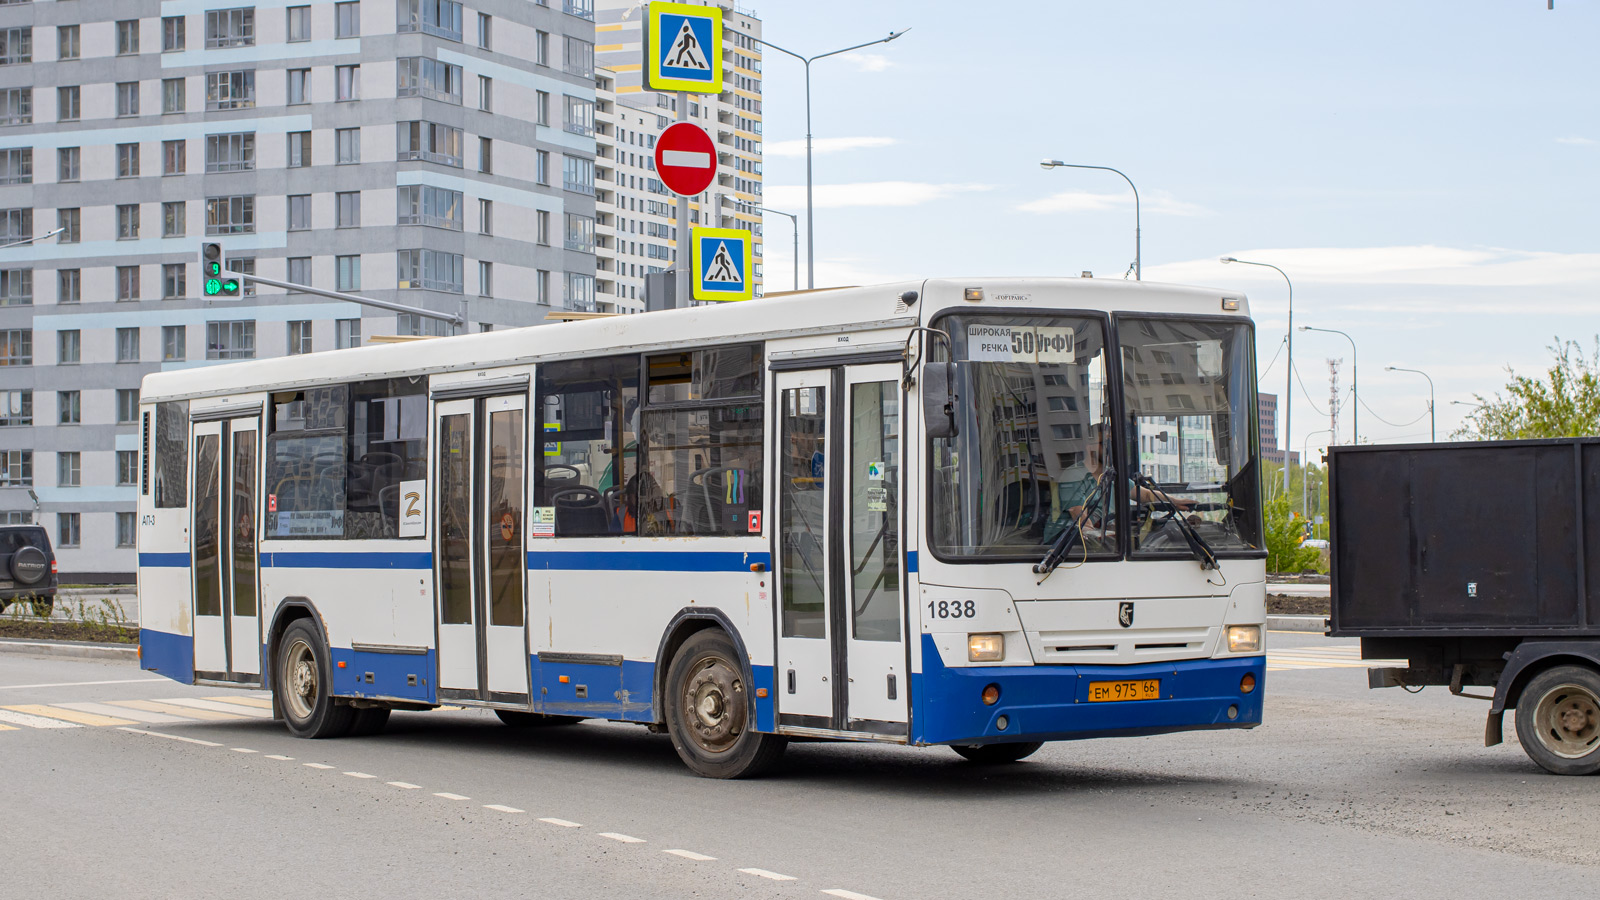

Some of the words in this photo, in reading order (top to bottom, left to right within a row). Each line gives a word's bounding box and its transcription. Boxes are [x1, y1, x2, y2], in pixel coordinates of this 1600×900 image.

[212, 263, 219, 275] 9
[969, 327, 1011, 337] ШИРОКАЯ
[981, 343, 1009, 352] РЕЧКА
[1011, 331, 1034, 354] 50
[1036, 334, 1074, 353] УрФУ
[142, 515, 155, 525] АП-3
[927, 600, 976, 618] 1838
[1114, 683, 1137, 698] 975
[1143, 681, 1155, 692] 66
